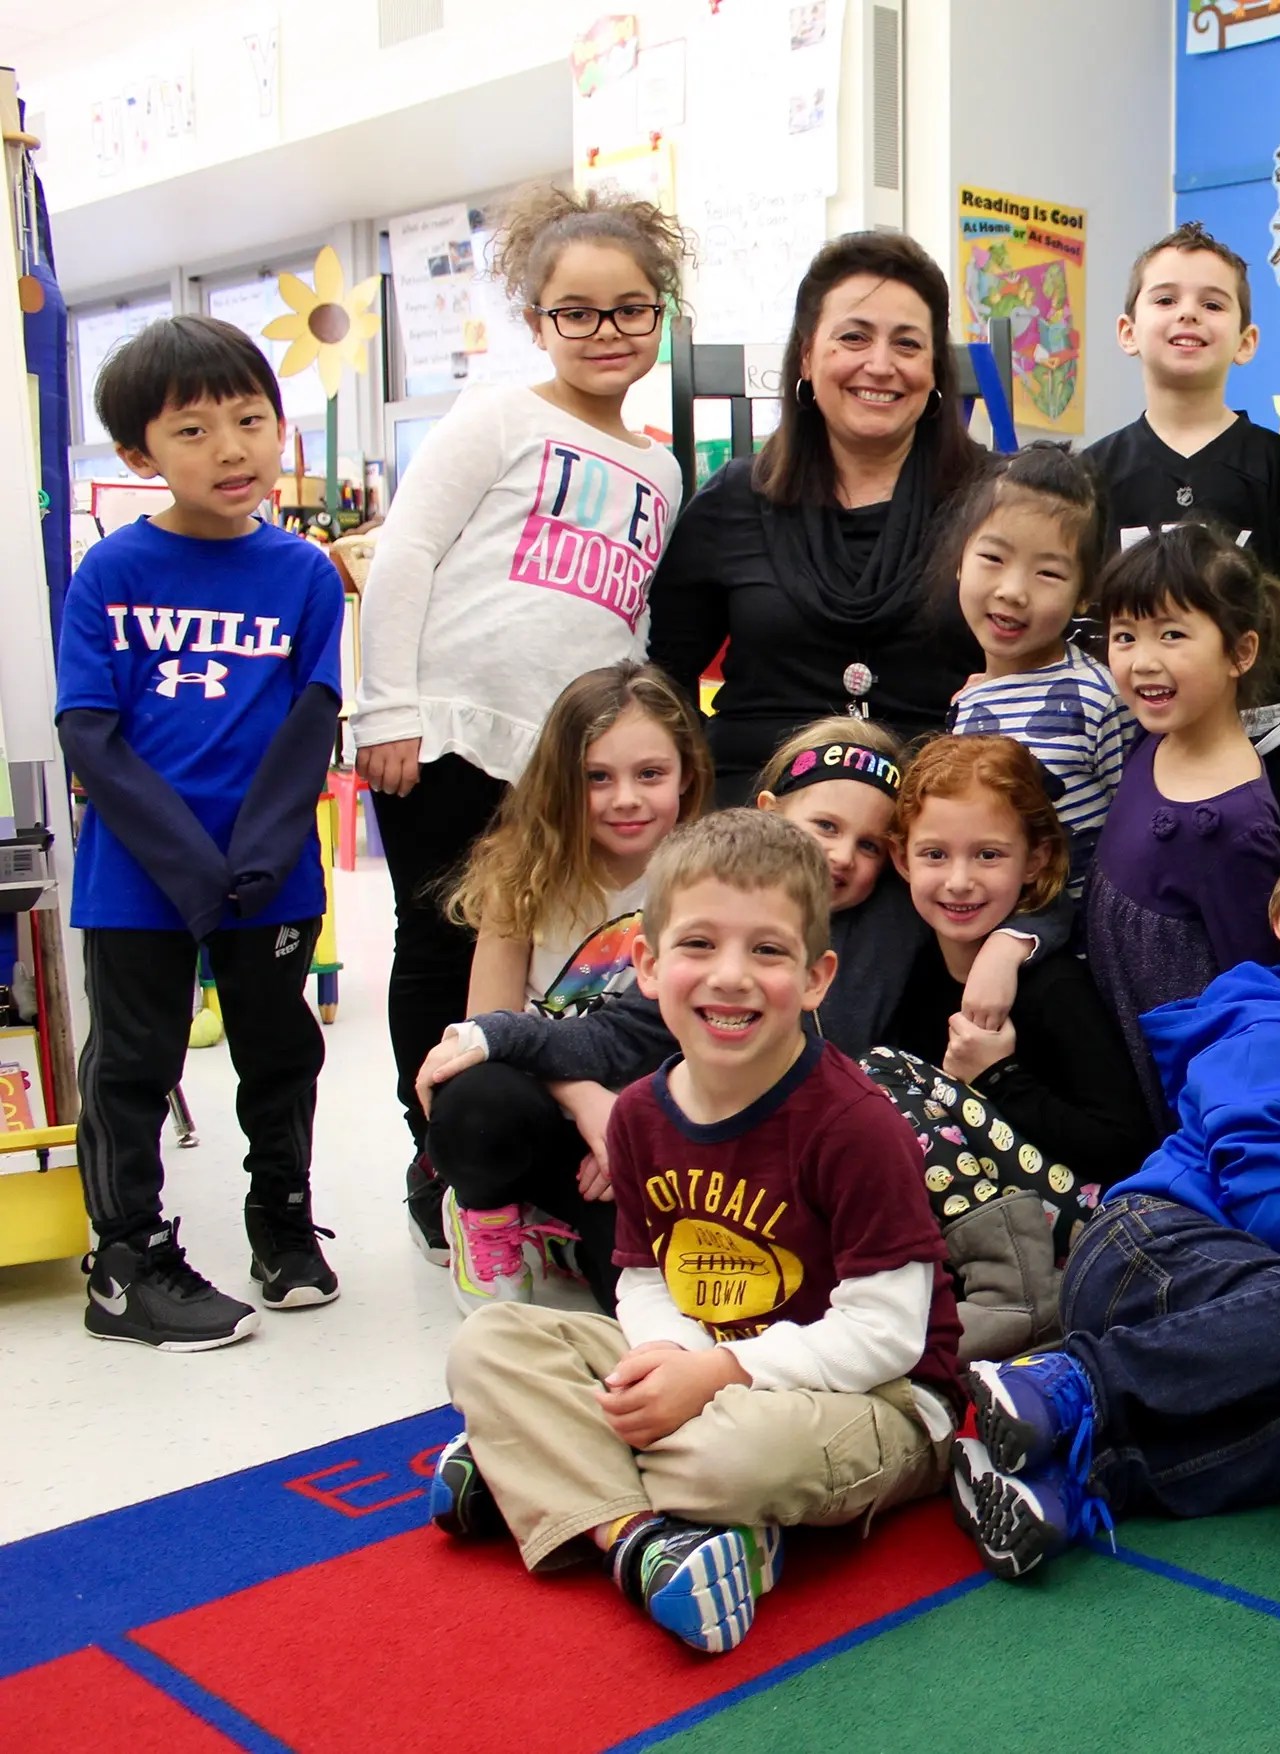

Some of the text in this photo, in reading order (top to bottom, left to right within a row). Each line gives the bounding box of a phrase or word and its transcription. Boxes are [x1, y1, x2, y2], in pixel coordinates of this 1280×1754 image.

[962, 190, 1030, 221] Reading
[1051, 209, 1083, 229] Cool
[963, 221, 1081, 256] At Home or At School
[106, 604, 292, 658] I WILL
[696, 1280, 748, 1306] DOWN
